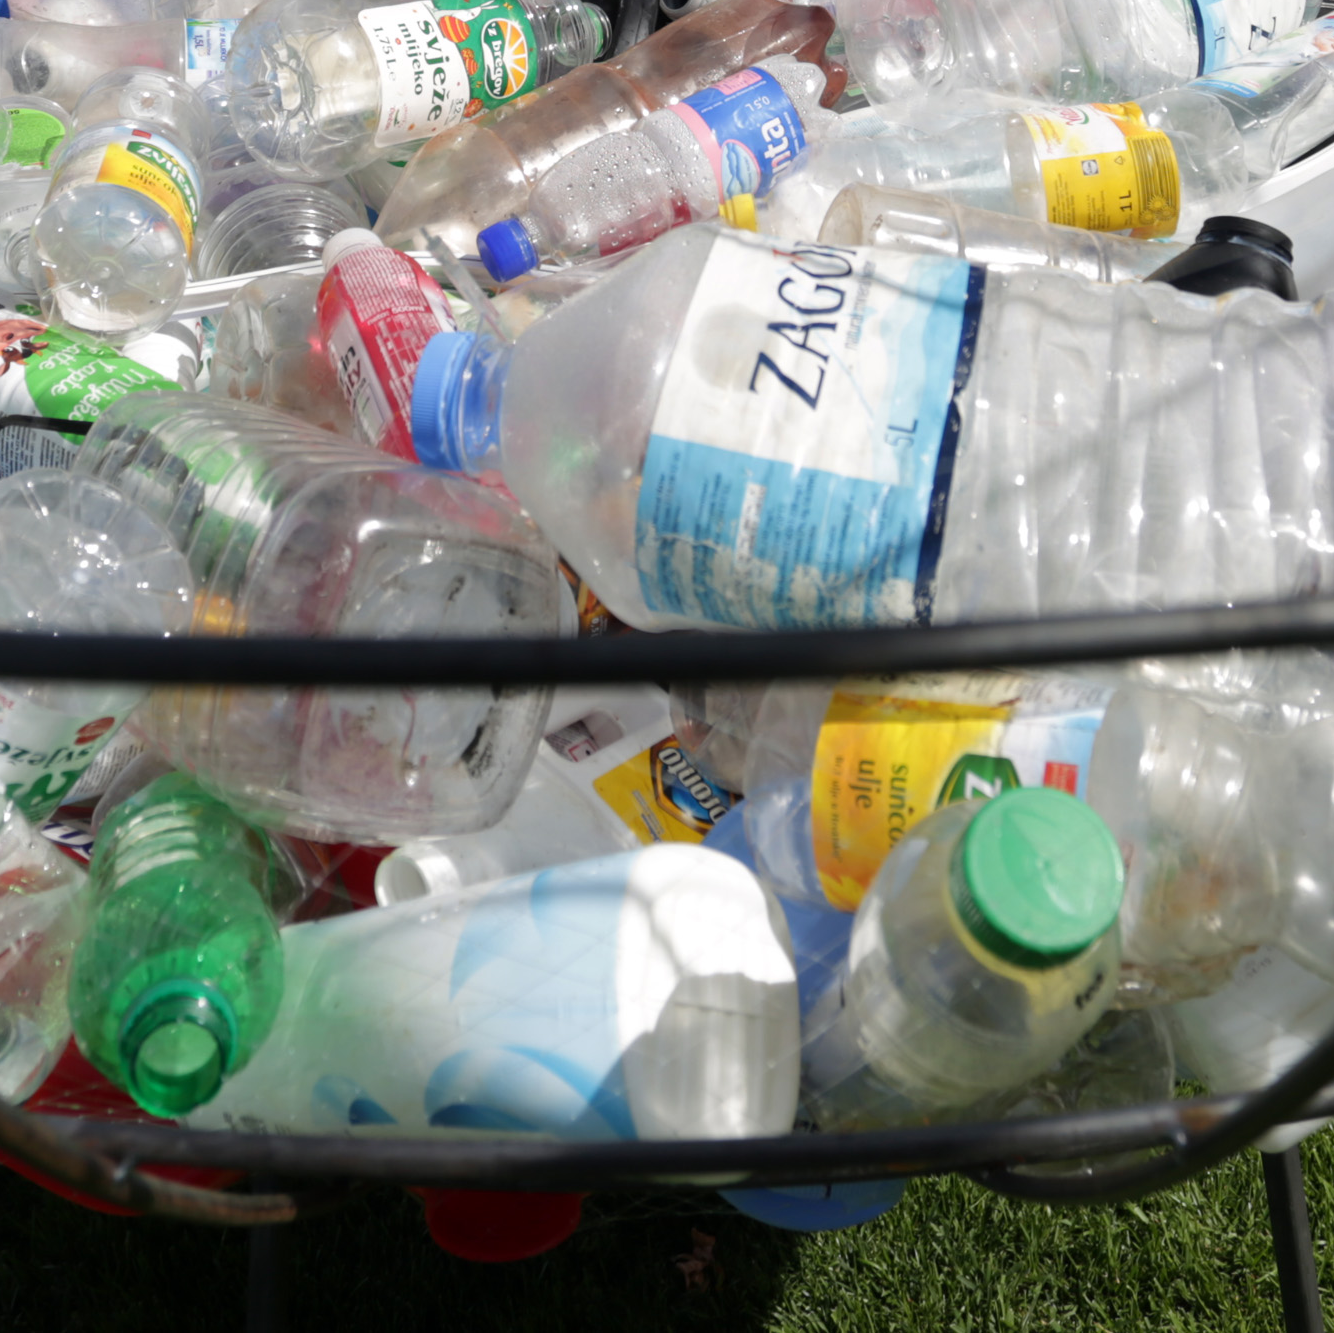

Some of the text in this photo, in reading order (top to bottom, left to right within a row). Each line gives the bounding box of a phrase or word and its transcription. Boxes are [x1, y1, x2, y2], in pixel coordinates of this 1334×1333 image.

[397, 22, 425, 96] mlijeko
[416, 19, 450, 122] svježe
[491, 38, 506, 98] bregov
[760, 116, 793, 174] nta
[844, 311, 865, 352] natural
[50, 358, 118, 397] Lapte
[883, 419, 918, 448] 5L
[848, 758, 883, 811] ulje
[887, 762, 910, 850] sunco
